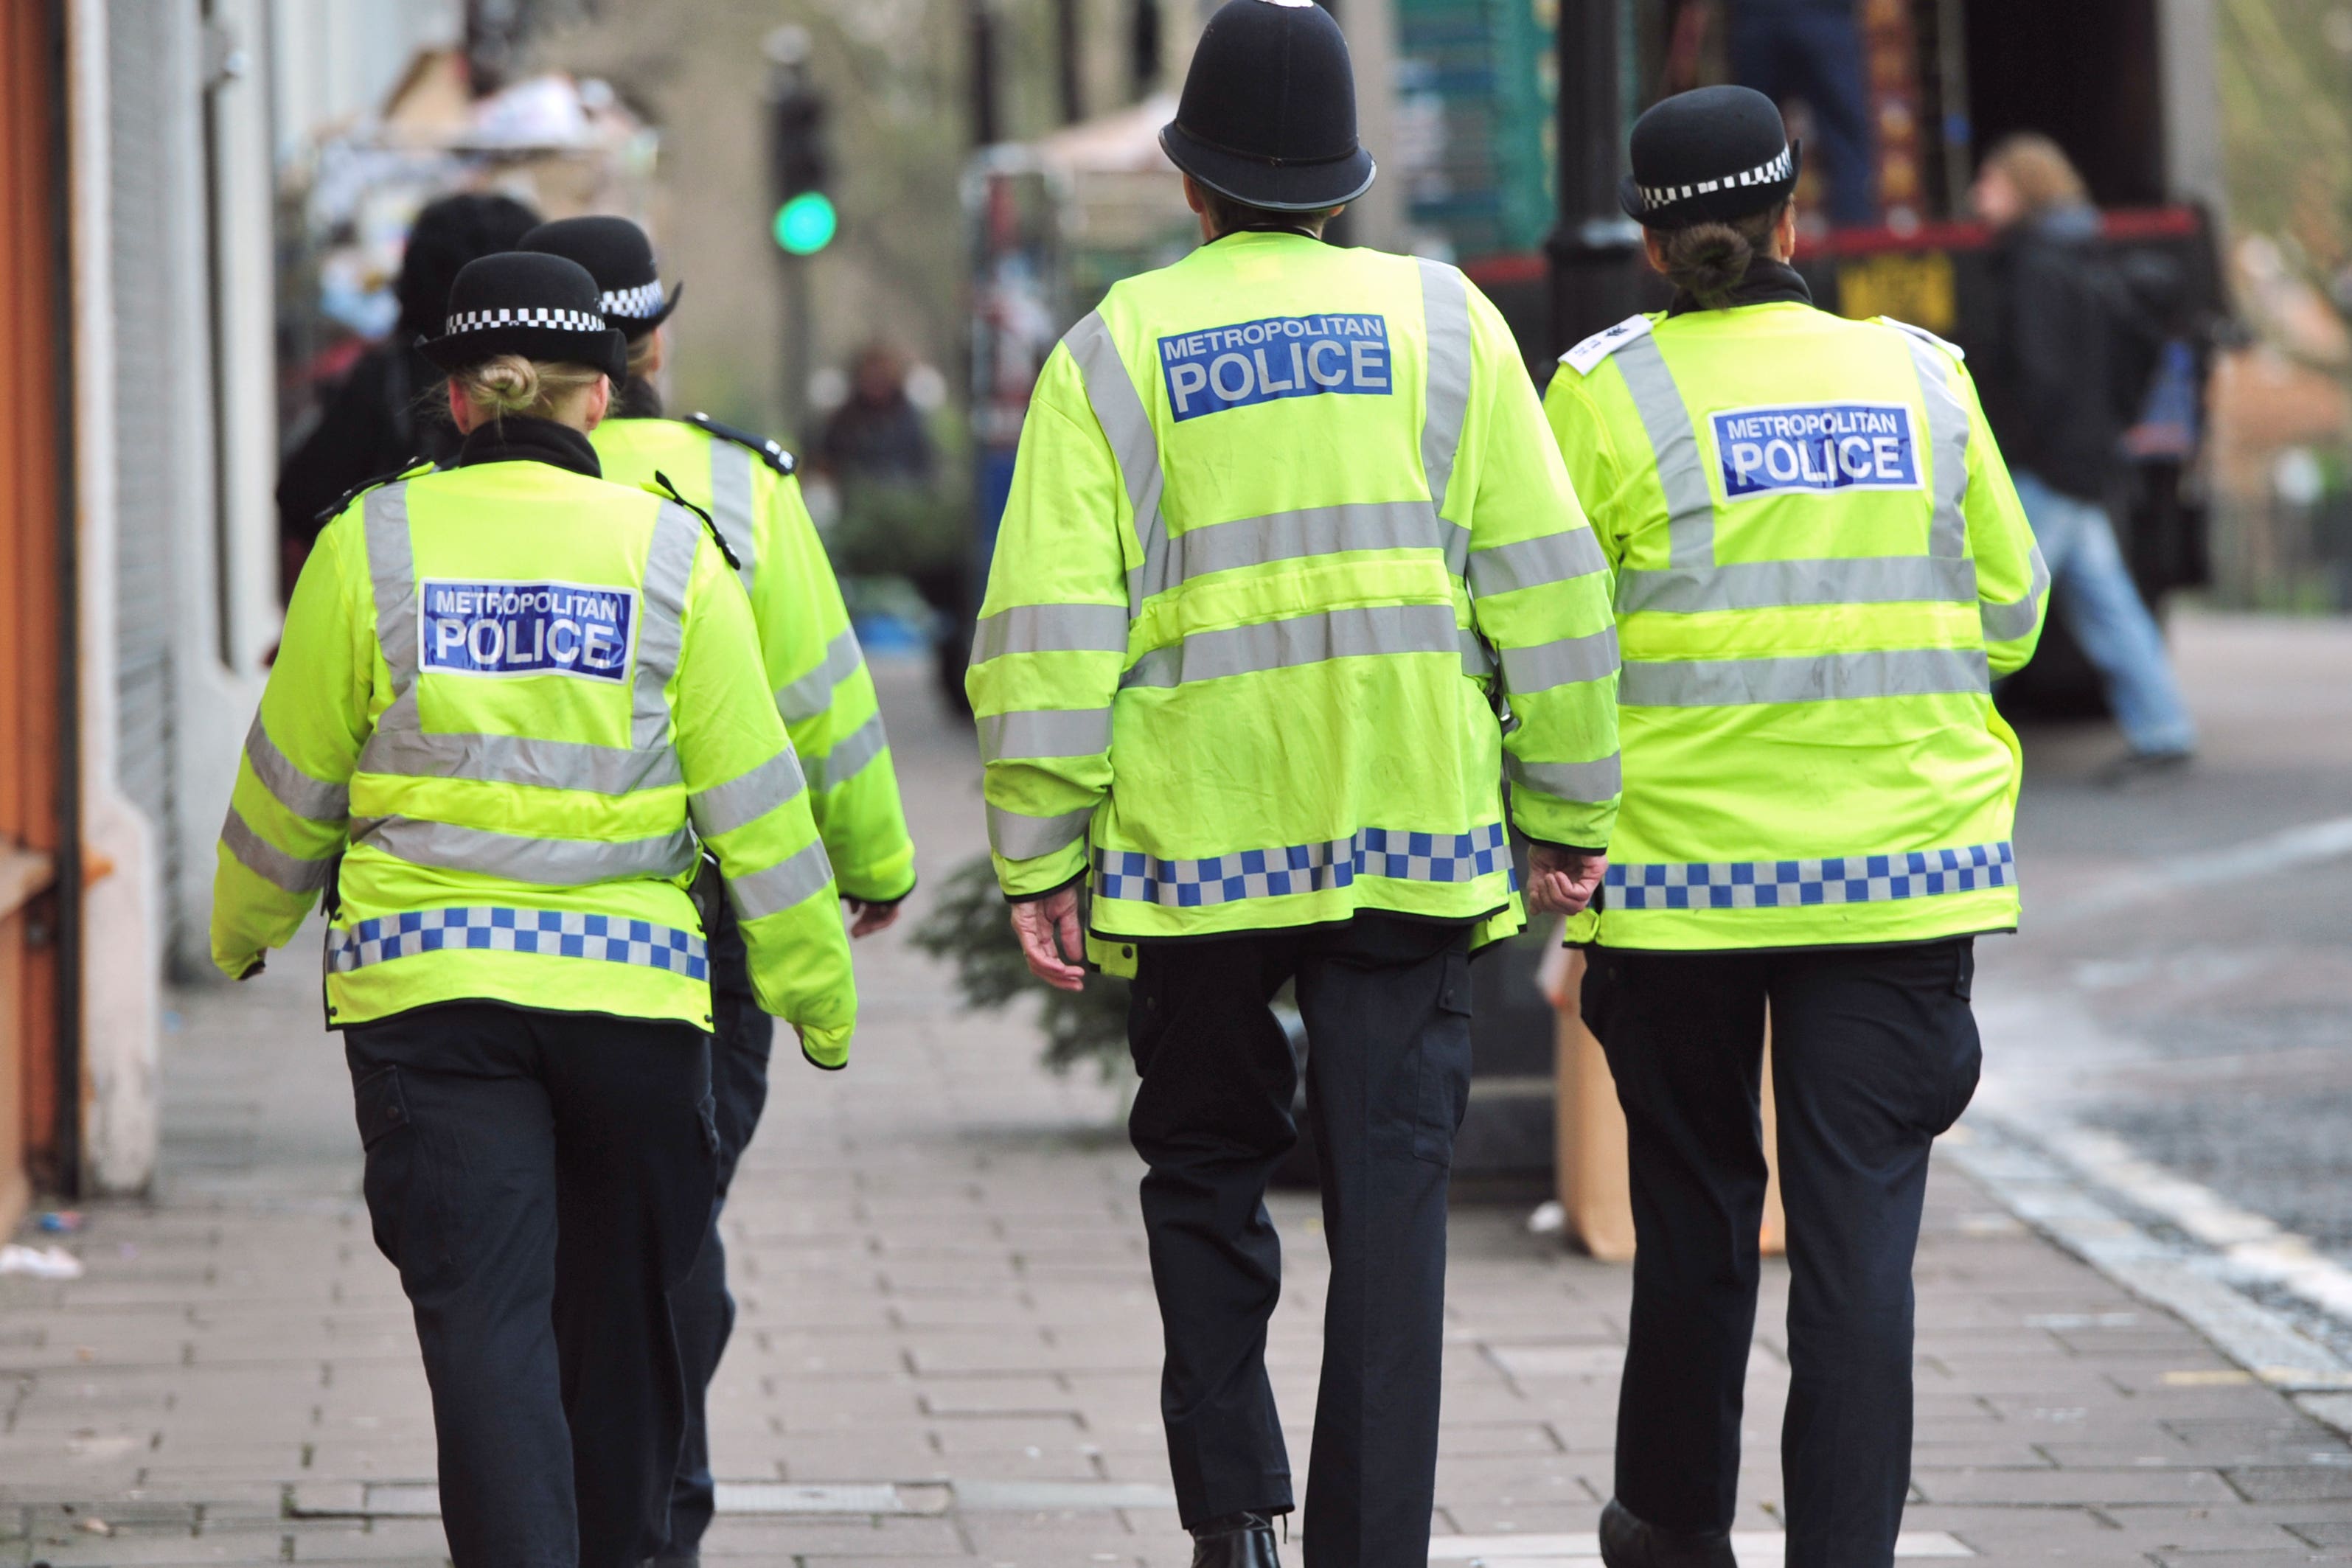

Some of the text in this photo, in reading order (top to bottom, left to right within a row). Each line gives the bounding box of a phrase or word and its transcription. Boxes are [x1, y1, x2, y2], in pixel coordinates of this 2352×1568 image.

[1163, 318, 1383, 360] METROPOLITAN
[1169, 340, 1387, 413] POLICE
[1726, 411, 1898, 440] METROPOLITAN
[1731, 436, 1904, 487] POLICE
[436, 590, 617, 621] METROPOLITAN
[436, 618, 614, 669] POLICE
